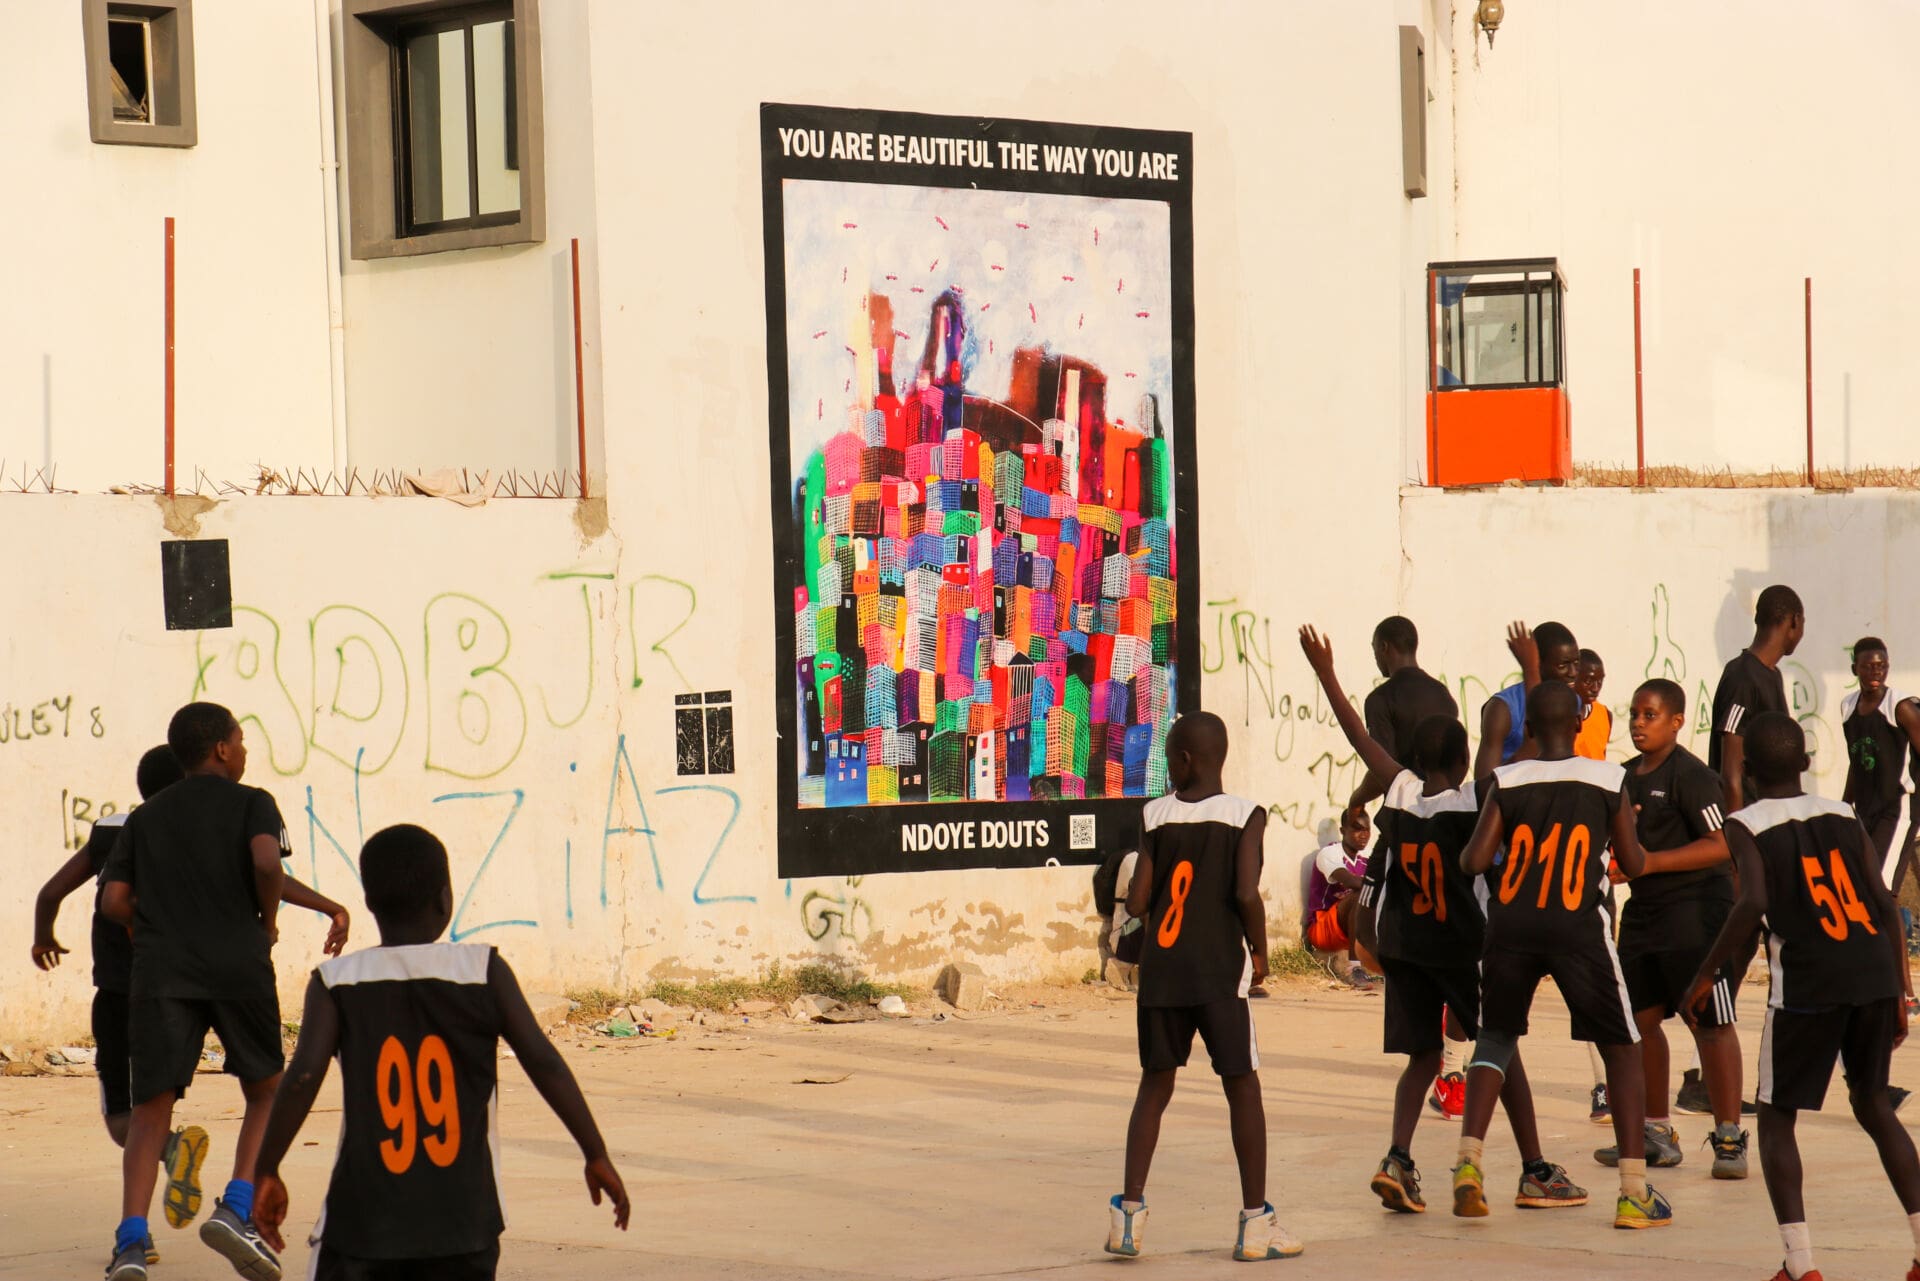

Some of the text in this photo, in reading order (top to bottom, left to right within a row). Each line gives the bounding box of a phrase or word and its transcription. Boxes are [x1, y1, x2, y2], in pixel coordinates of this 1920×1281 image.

[779, 128, 1179, 181] YOU ARE BEAUTIFUL THE WAY YOU ARE
[902, 819, 1050, 852] NDOYE DOUTS
[1499, 823, 1590, 911] 010
[1157, 860, 1194, 949] 8
[1401, 842, 1447, 922] 50
[1801, 848, 1878, 941] 54
[376, 1034, 460, 1174] 99
